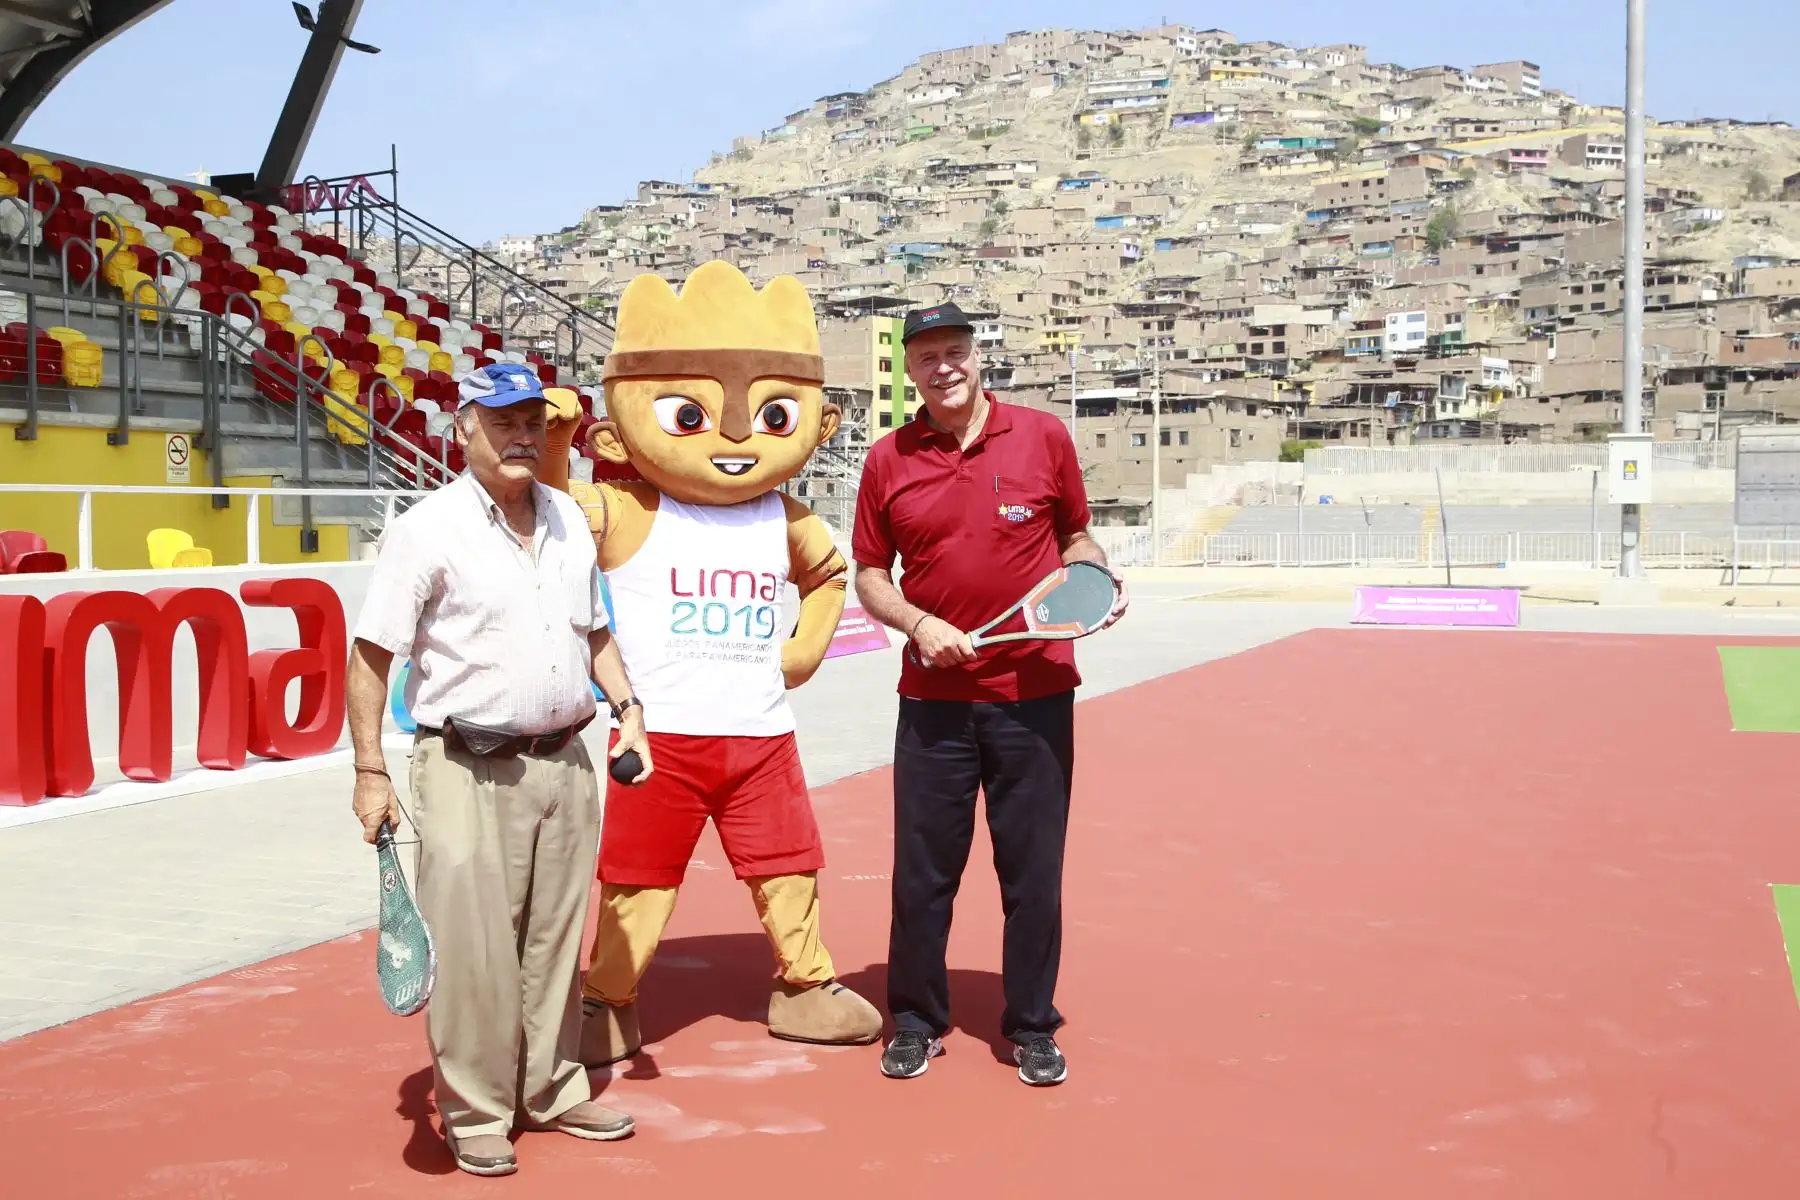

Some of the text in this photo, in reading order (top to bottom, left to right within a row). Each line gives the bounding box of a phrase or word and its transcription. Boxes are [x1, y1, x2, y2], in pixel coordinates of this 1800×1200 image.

[922, 313, 940, 322] 2019
[1008, 512, 1025, 522] 2019
[670, 601, 775, 640] 2019
